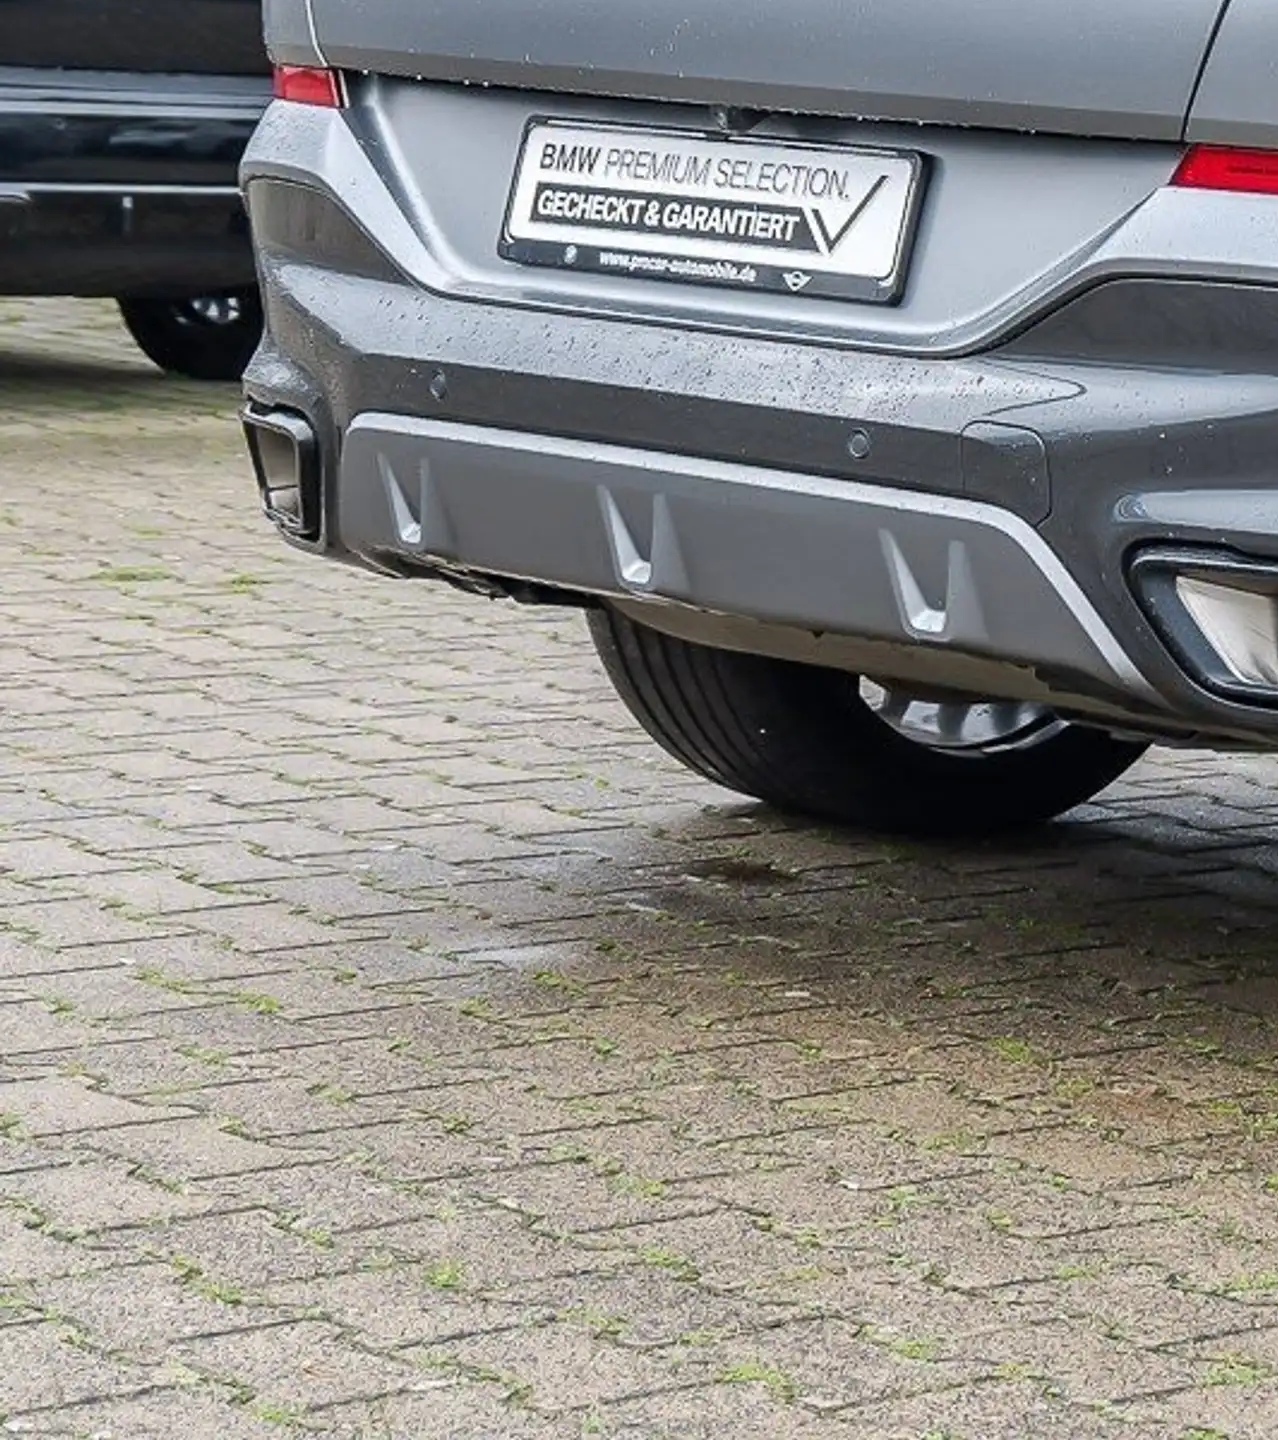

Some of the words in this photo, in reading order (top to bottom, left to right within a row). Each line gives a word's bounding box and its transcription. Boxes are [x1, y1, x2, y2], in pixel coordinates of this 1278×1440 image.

[540, 143, 602, 174] BMW
[604, 149, 711, 187] PREMIUM
[713, 159, 851, 201] SELECTION.
[537, 189, 645, 225] GECHECKT
[644, 202, 661, 228] &
[663, 202, 801, 242] GARANTIERT
[600, 252, 756, 282] www.procar-automobile.de
